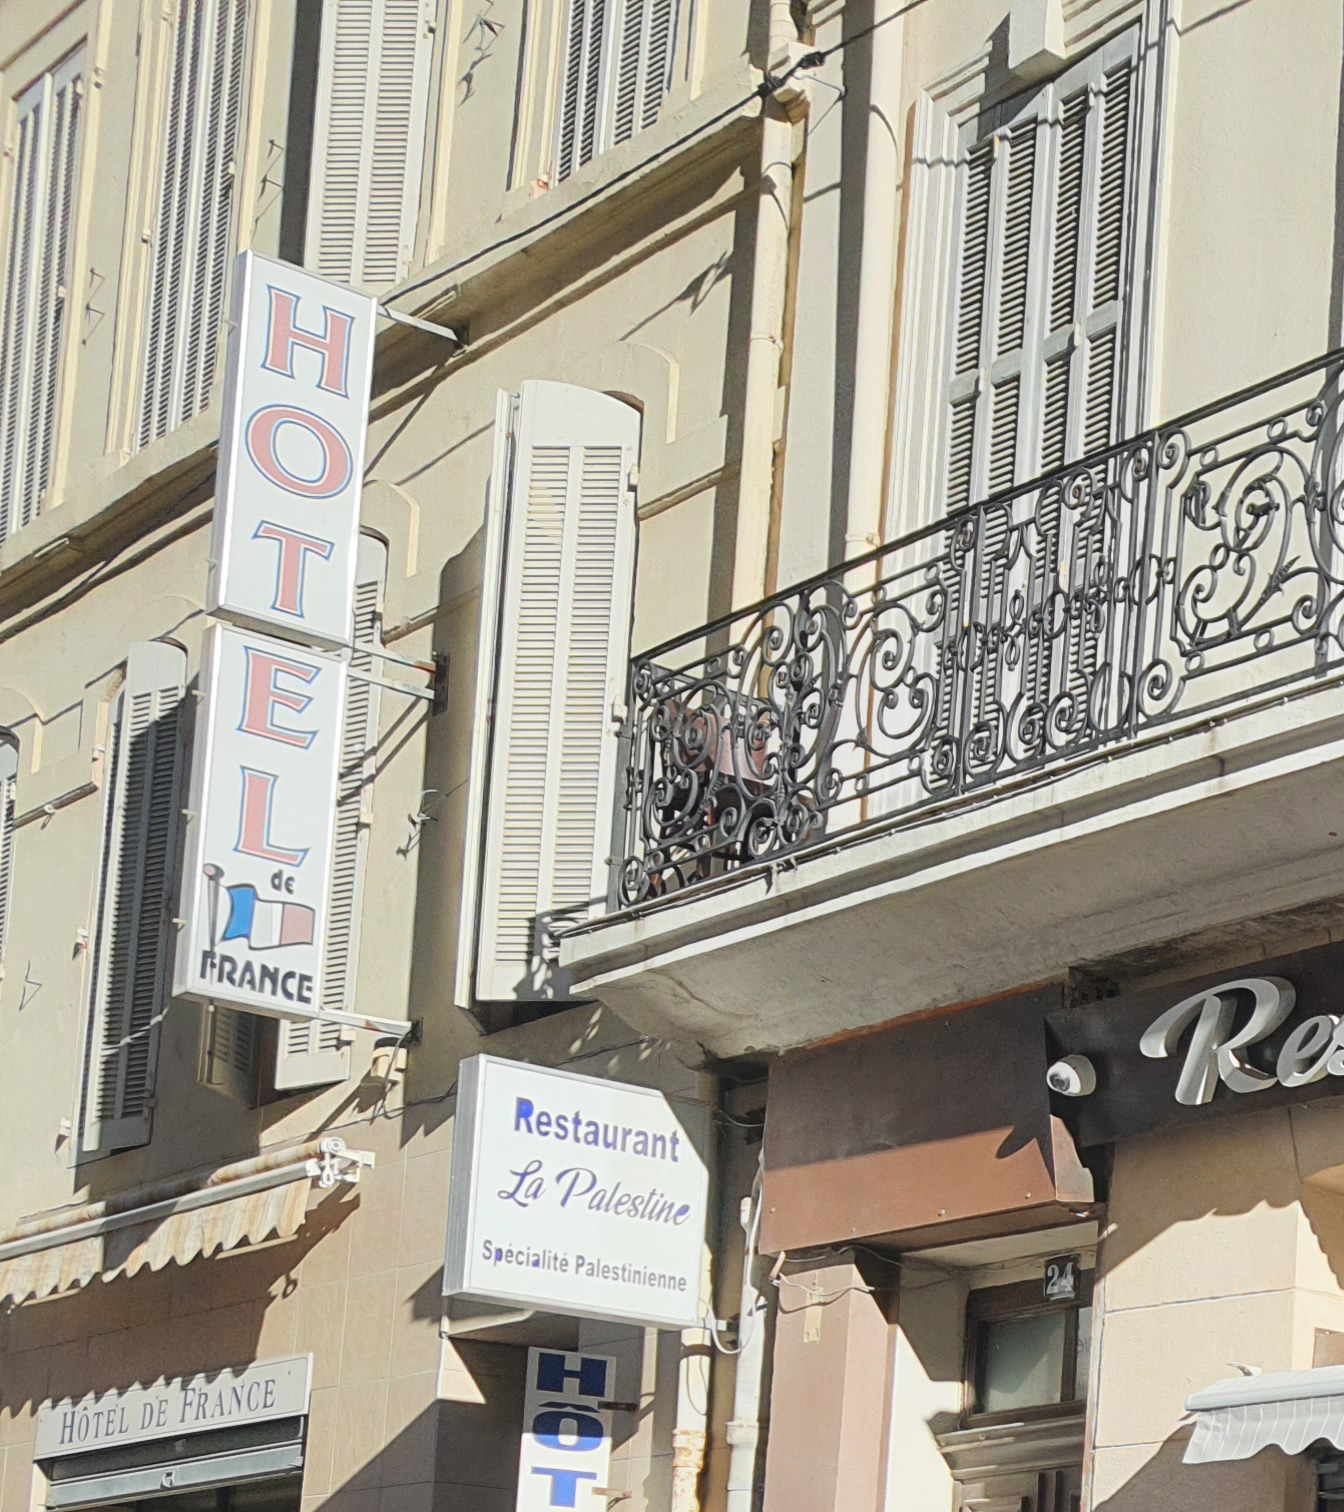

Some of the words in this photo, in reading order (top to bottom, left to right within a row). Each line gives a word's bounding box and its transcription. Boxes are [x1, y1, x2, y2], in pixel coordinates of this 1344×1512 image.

[233, 284, 356, 867] HOTEL
[270, 869, 295, 895] de
[200, 950, 314, 1004] FRANCE
[513, 1096, 680, 1162] Restaurant
[497, 1159, 546, 1208] La
[555, 1167, 691, 1226] Palestine
[482, 1239, 569, 1273] Spécialité
[575, 1254, 687, 1292] Palestinienne
[1046, 1261, 1075, 1295] 24
[58, 1406, 129, 1445] HÔTEL
[140, 1398, 168, 1431] DE
[179, 1378, 276, 1424] FRANCE
